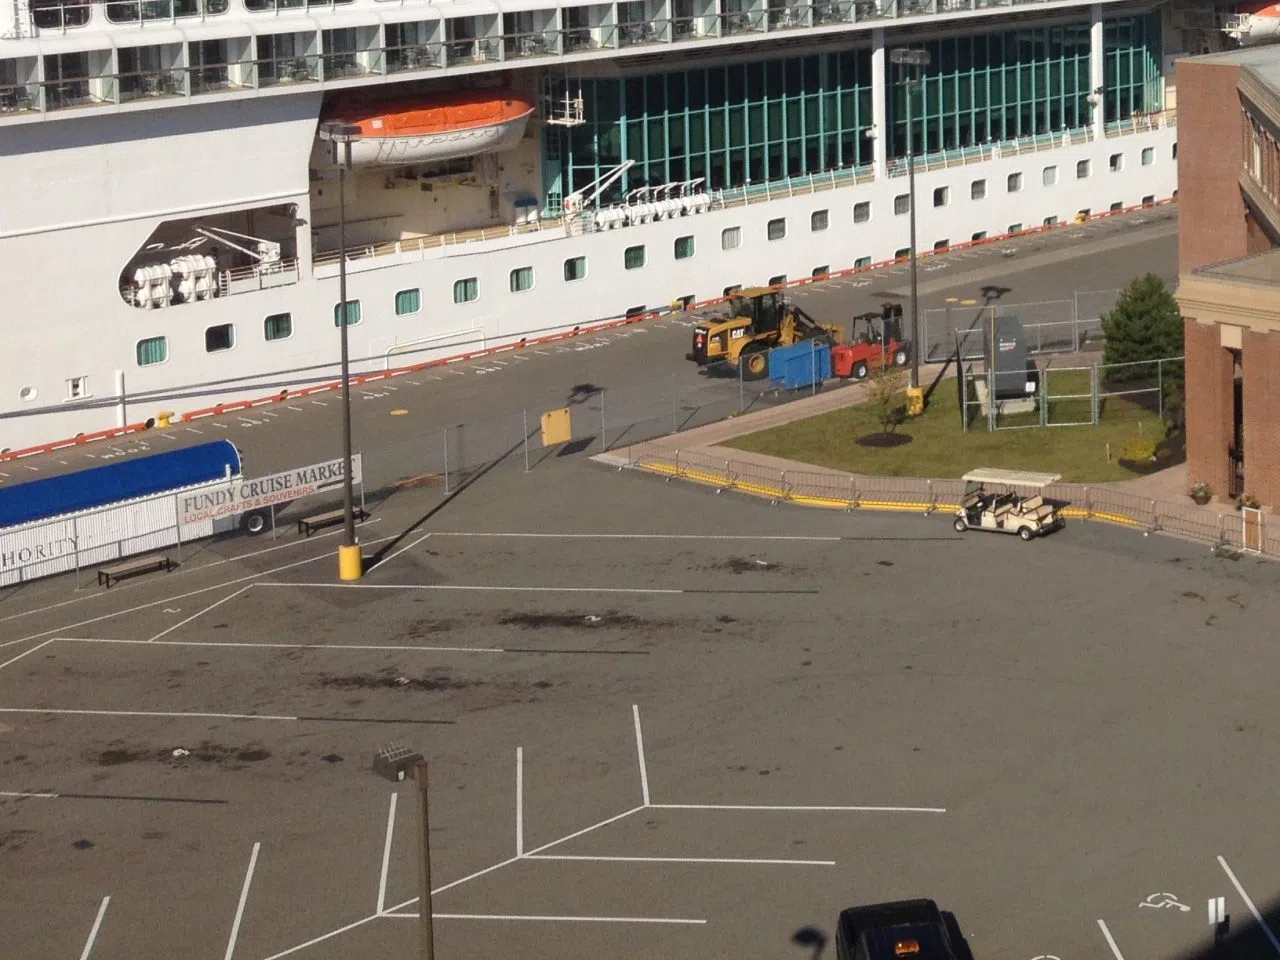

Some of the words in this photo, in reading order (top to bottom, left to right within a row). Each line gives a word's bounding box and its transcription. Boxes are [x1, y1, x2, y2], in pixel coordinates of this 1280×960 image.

[732, 329, 744, 339] CAT
[184, 487, 236, 513] FUNDY
[240, 473, 293, 500] CRUISE
[184, 510, 215, 523] LOCAL
[217, 501, 252, 515] CRAFTS
[254, 498, 261, 506] &
[263, 485, 315, 505] SOUVENIRS
[2, 536, 80, 567] HORITY
